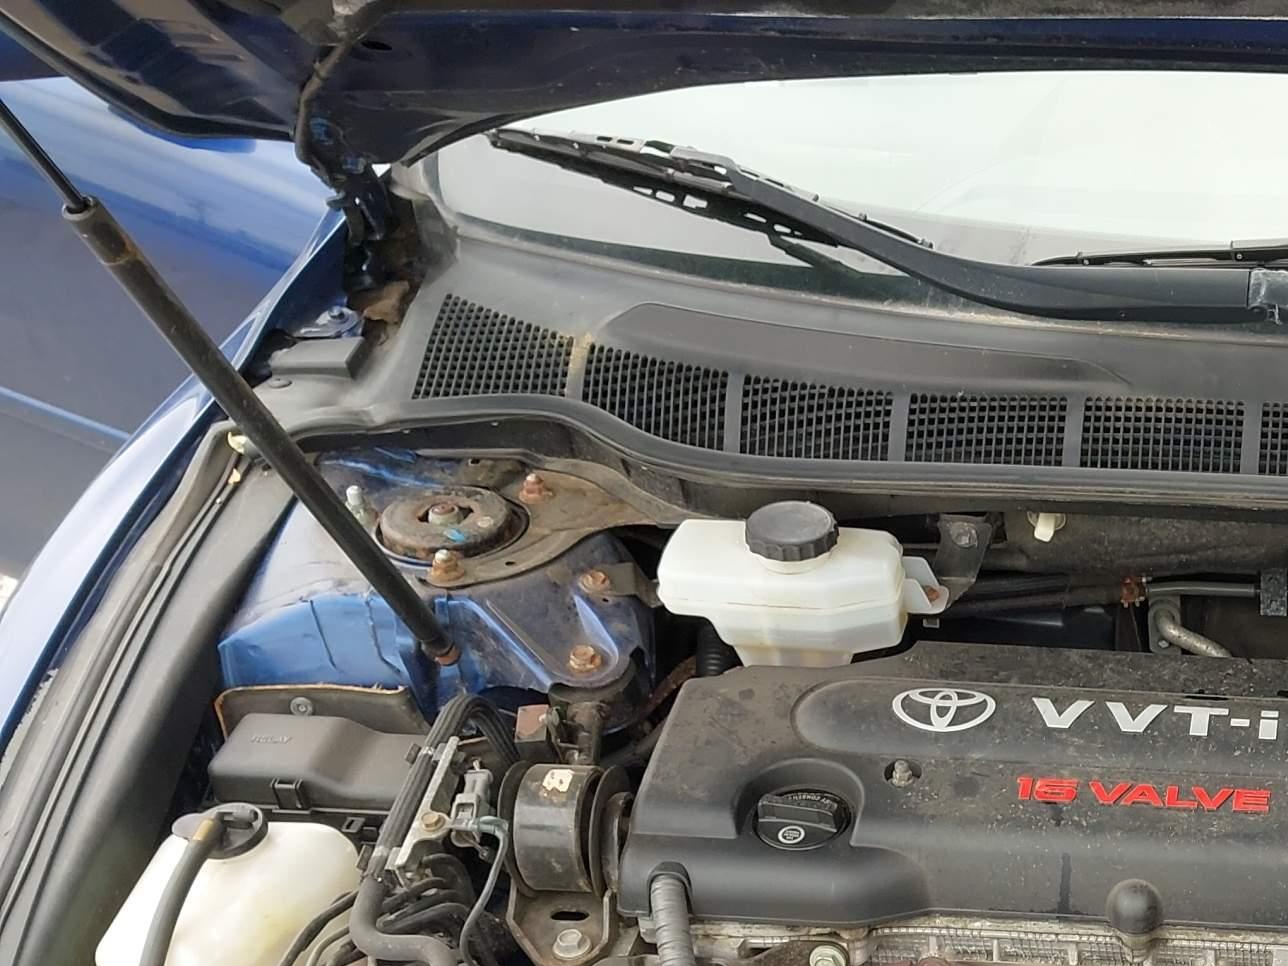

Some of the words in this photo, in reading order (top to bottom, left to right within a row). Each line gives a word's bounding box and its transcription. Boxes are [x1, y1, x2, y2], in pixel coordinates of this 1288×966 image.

[1032, 697, 1279, 740] VVT-i
[1016, 775, 1079, 804] 16
[1088, 779, 1272, 813] VALVE
